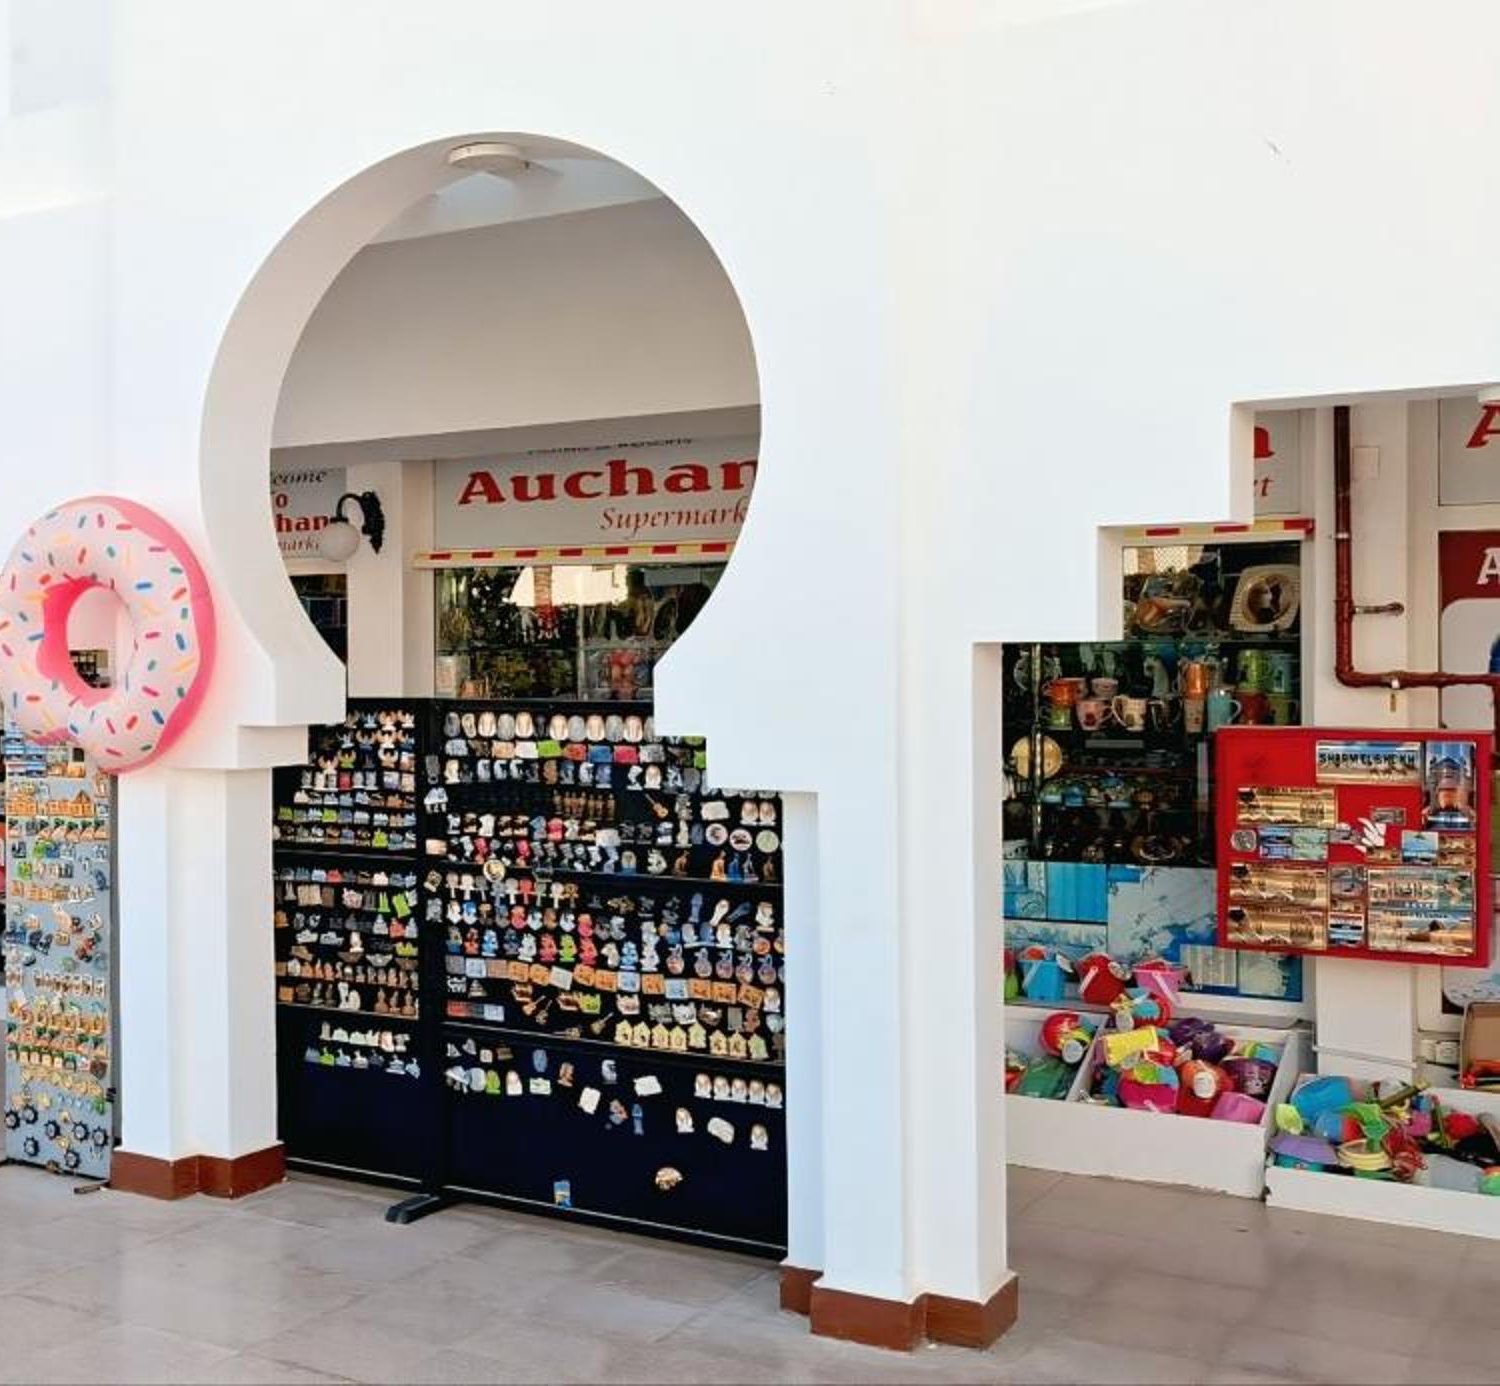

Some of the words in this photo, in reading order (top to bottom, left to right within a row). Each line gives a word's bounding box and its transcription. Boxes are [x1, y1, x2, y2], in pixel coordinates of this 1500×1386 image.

[1466, 401, 1500, 449] A
[274, 513, 329, 532] han
[600, 496, 750, 540] Supermark
[1476, 547, 1500, 586] A
